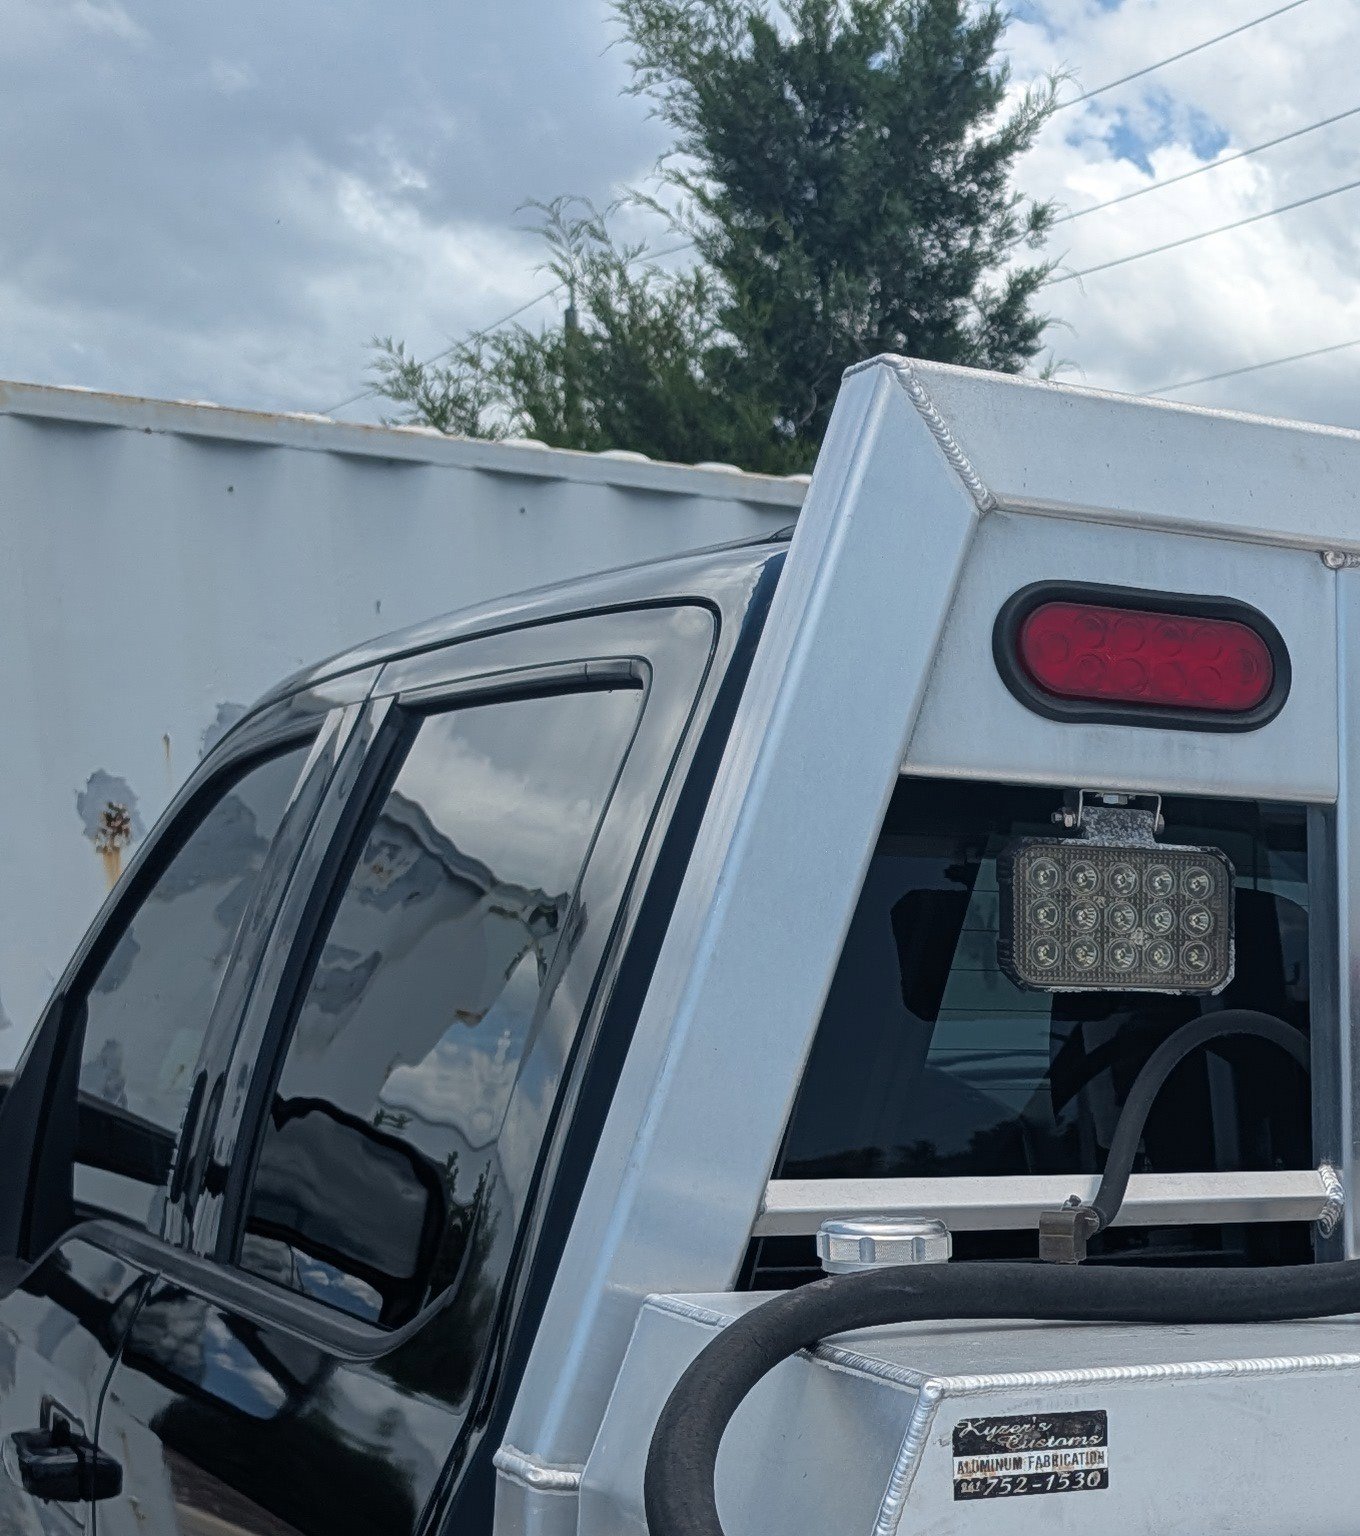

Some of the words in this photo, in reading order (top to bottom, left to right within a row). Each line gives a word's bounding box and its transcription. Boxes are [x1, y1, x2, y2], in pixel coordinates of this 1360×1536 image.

[998, 1433, 1104, 1450] Customs
[956, 1456, 1023, 1475] ALUMINUM
[1027, 1450, 1105, 1471] FABRICATION
[983, 1470, 1101, 1497] 752-1530
